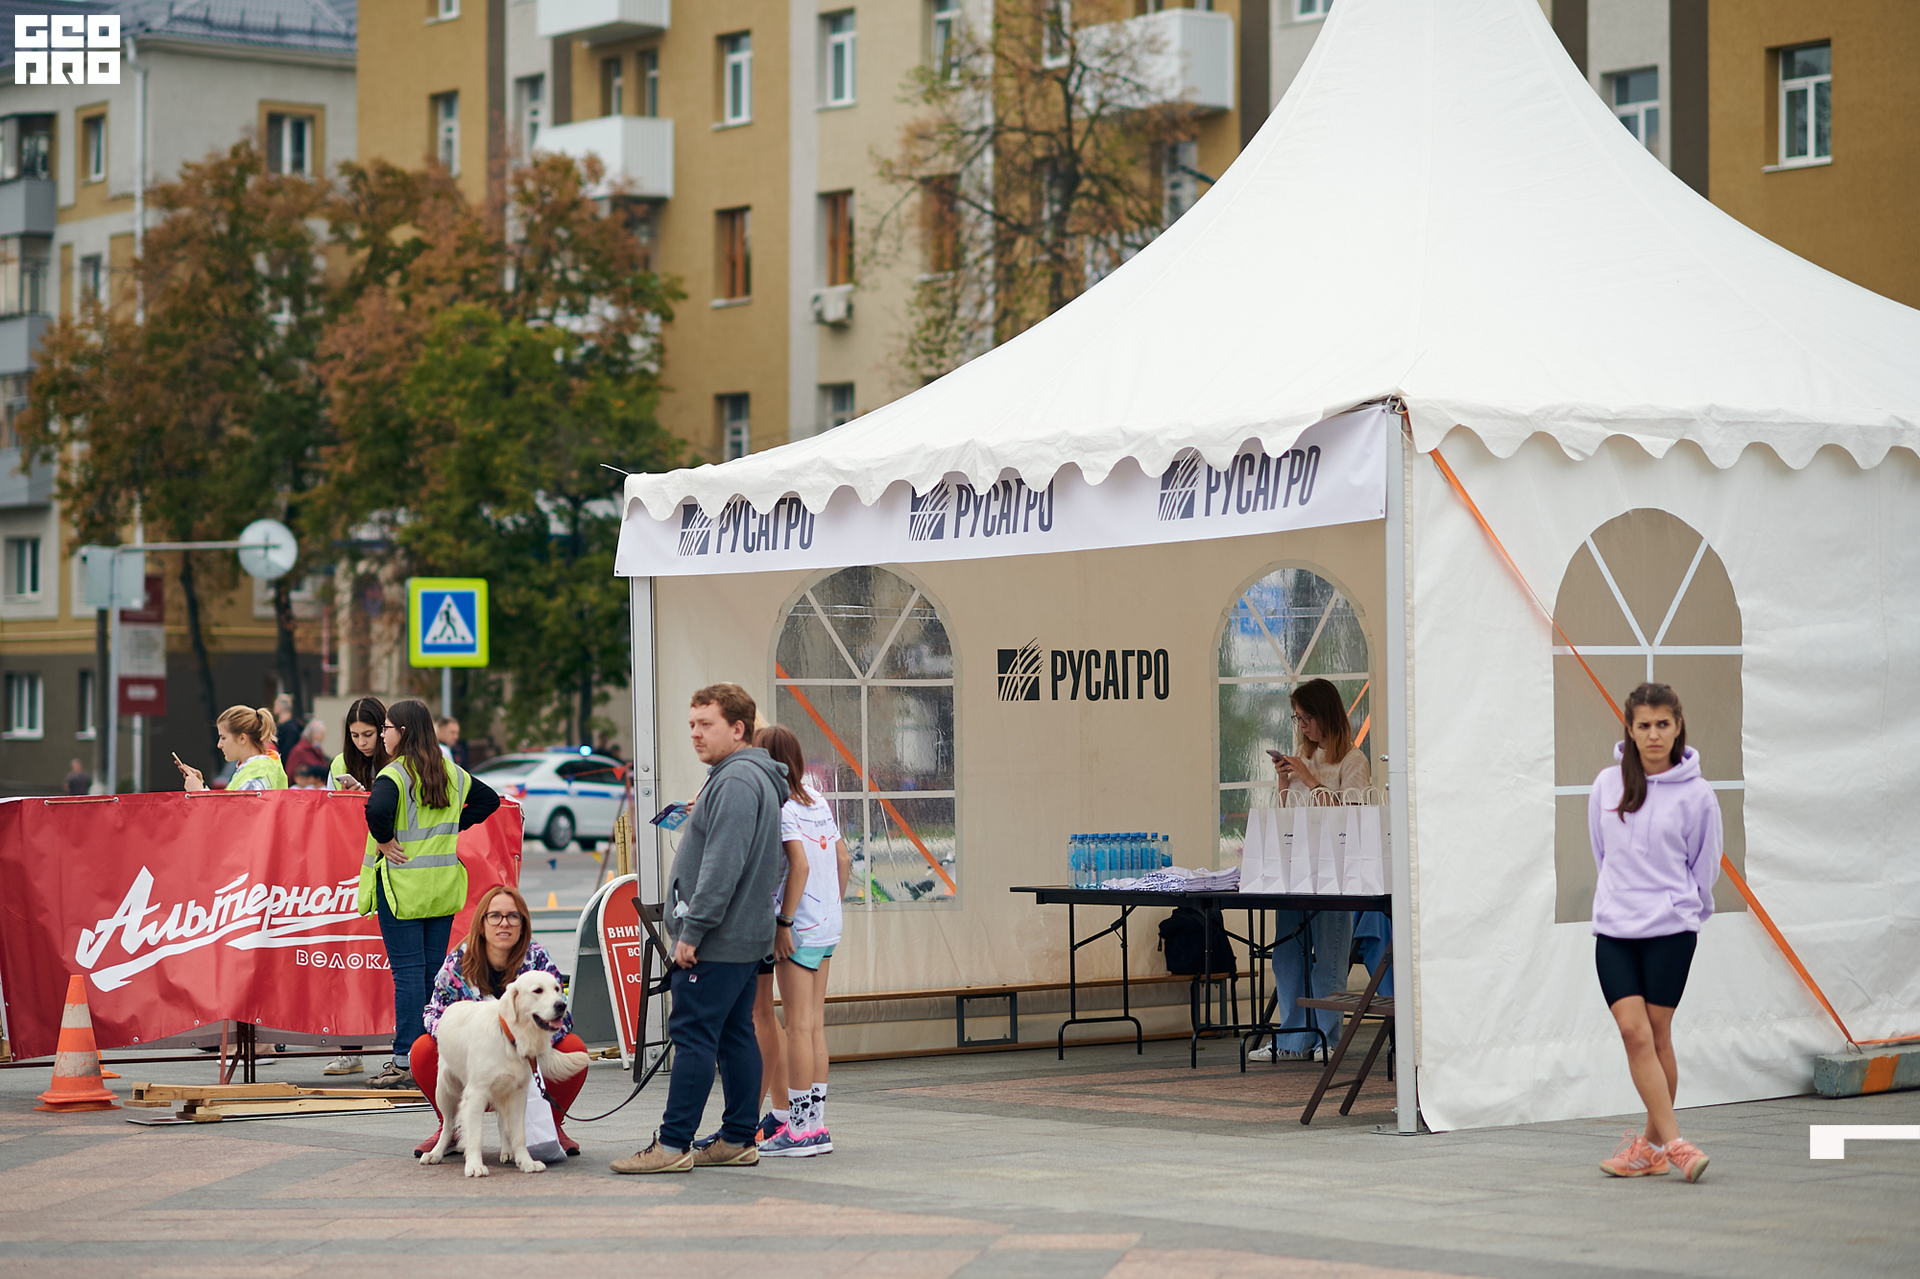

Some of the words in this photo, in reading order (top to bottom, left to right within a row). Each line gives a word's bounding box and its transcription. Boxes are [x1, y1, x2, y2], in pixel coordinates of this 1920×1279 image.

[953, 478, 1054, 539] РУСАГРО
[1204, 445, 1321, 517] РУСАГРО
[716, 497, 815, 553] РУСАГРО
[1050, 648, 1169, 701] РУСАГРО
